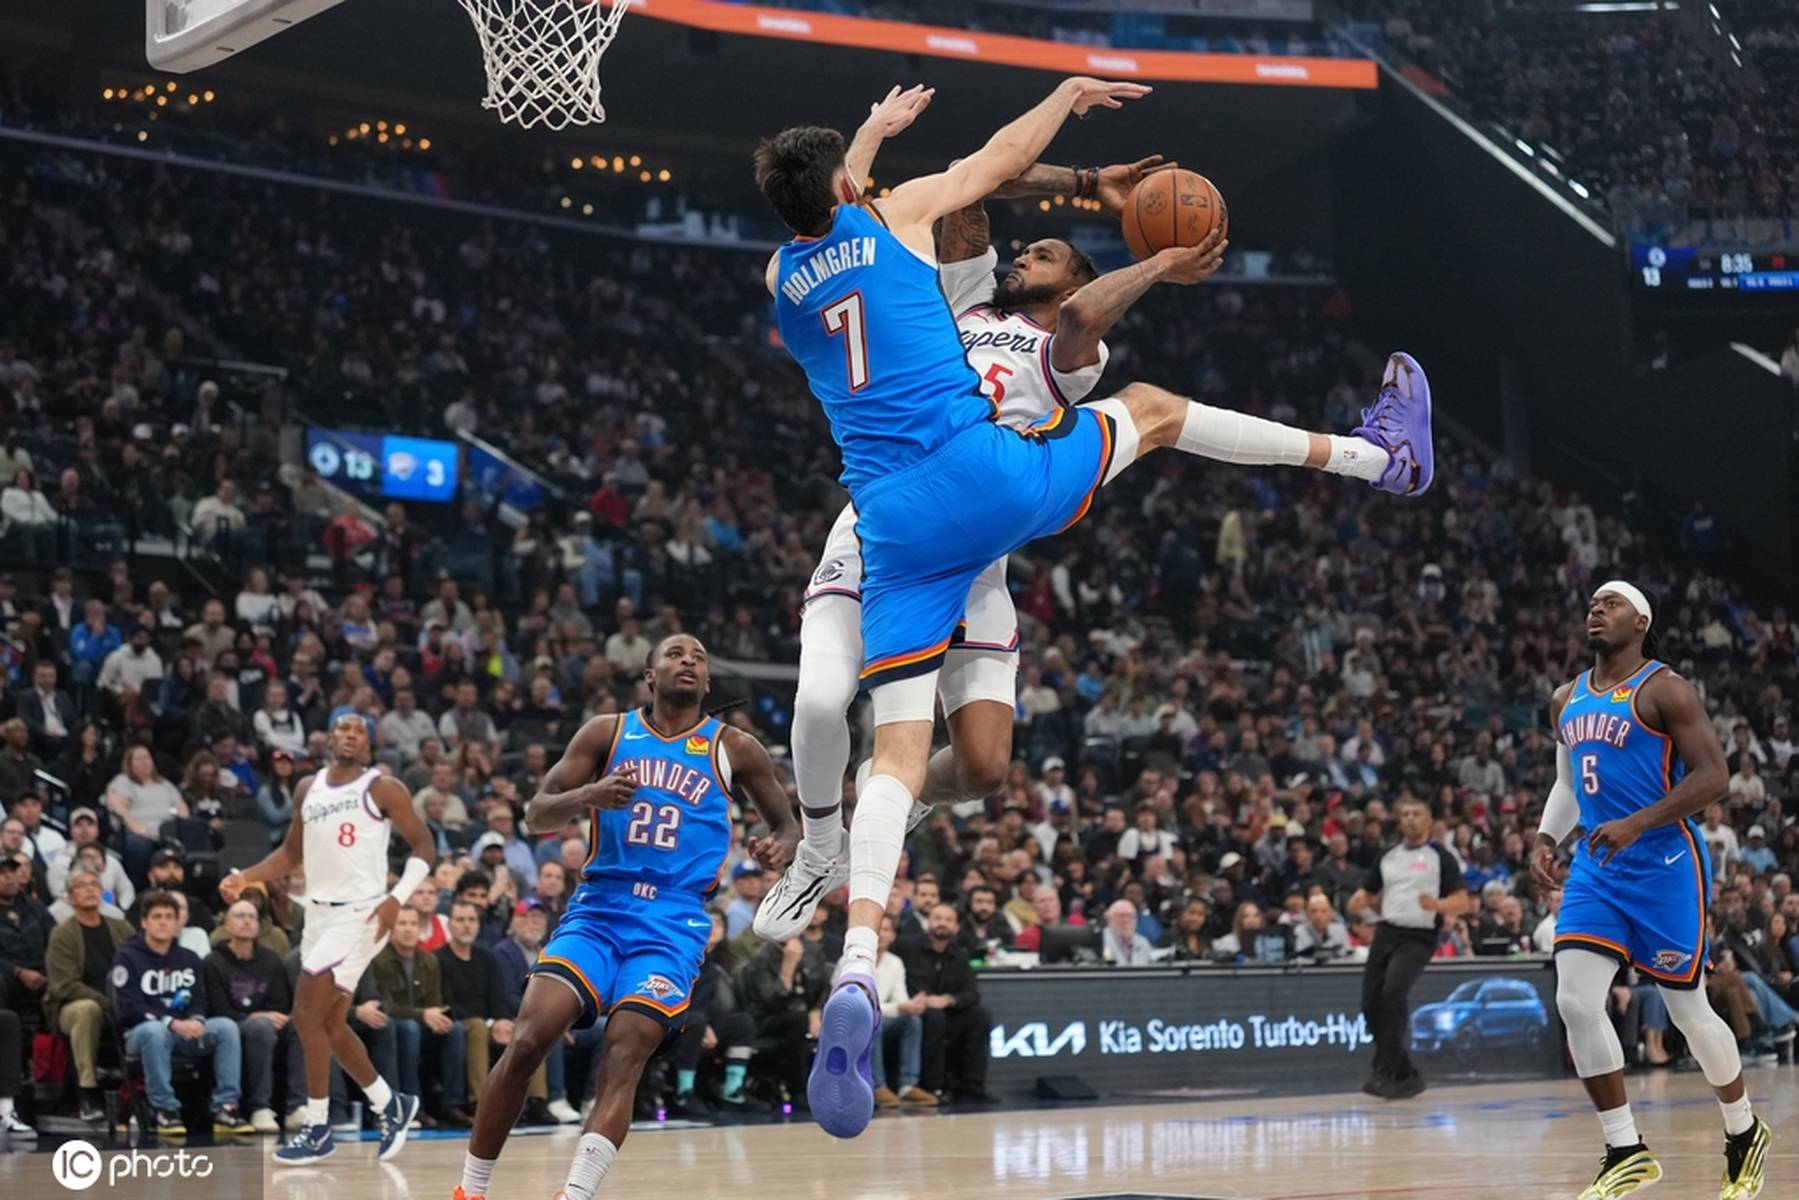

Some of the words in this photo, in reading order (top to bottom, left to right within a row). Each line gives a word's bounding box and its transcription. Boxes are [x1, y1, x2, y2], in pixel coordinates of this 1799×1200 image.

[781, 237, 876, 306] HOLMGREN
[821, 288, 869, 395] 7
[984, 363, 1014, 404] 5
[344, 449, 373, 480] 13
[427, 459, 445, 487] 3
[1561, 713, 1631, 750] THUNDER
[1581, 754, 1600, 796] 5
[338, 822, 356, 848] 8
[627, 801, 681, 849] 22
[632, 882, 658, 900] OKC
[141, 967, 195, 996] Clips
[1099, 1020, 1143, 1054] Kia
[1148, 1018, 1245, 1053] Sorento
